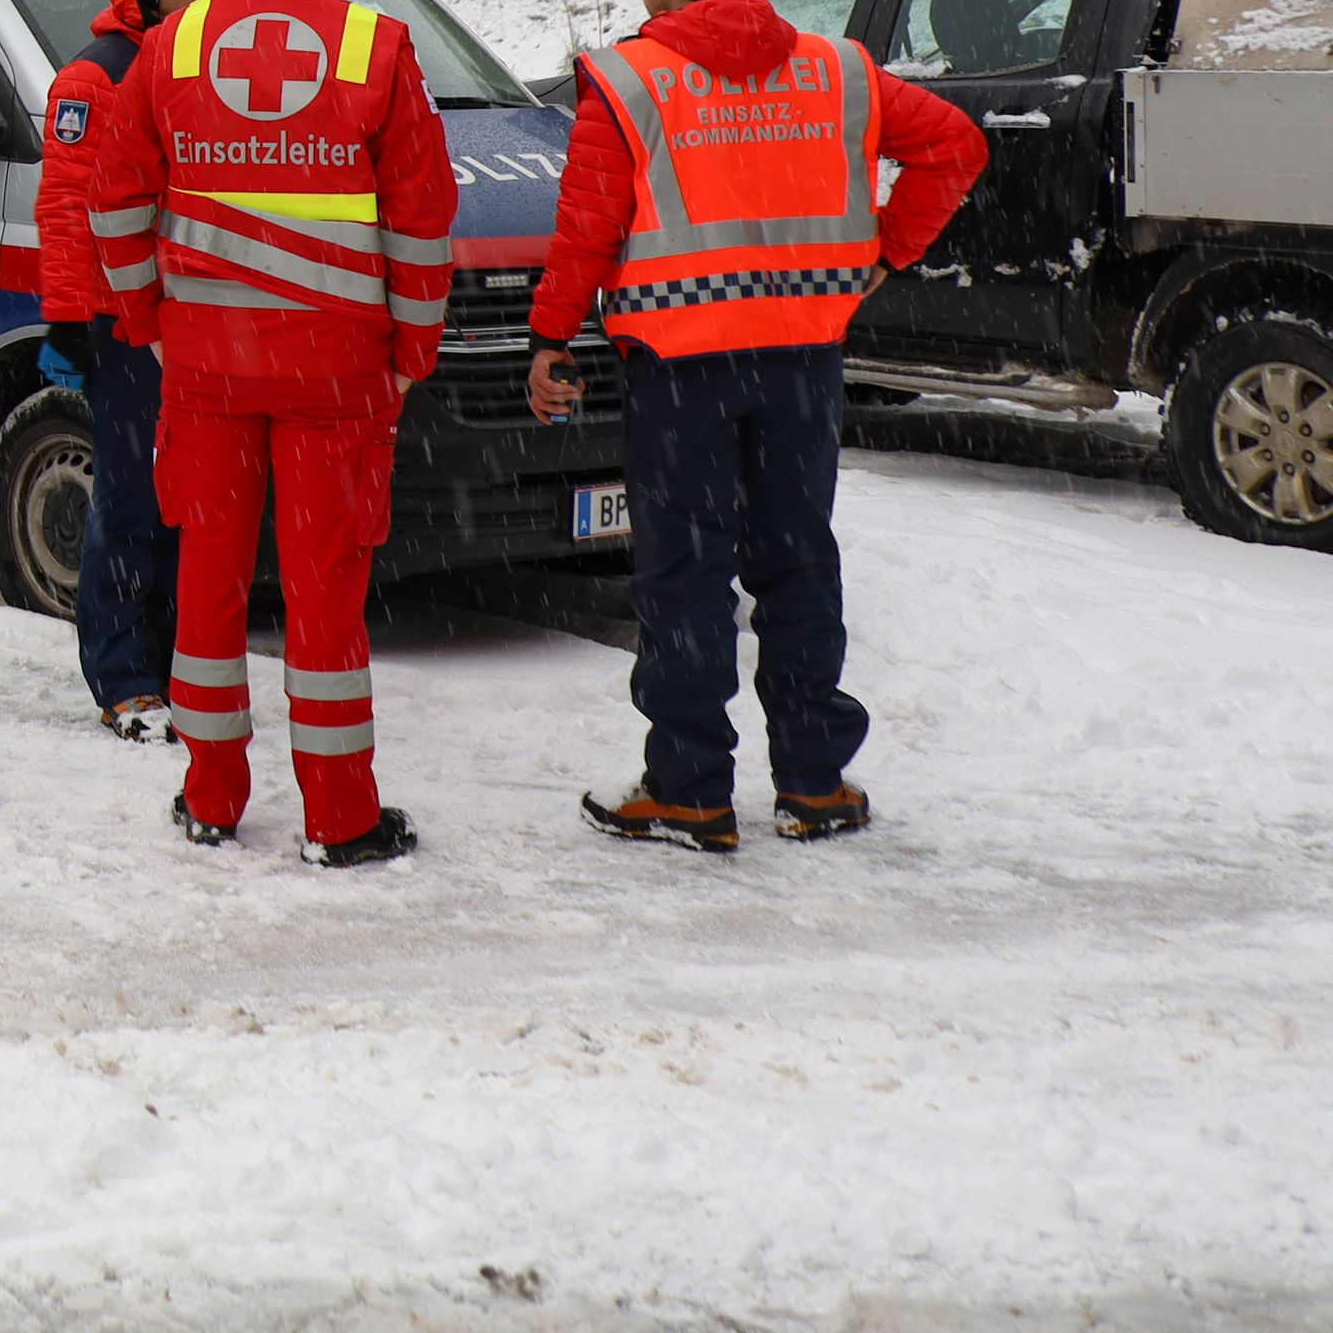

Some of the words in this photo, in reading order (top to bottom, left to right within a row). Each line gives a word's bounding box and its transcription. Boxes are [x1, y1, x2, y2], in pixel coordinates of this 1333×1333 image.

[649, 57, 830, 104] POLIZEI
[173, 130, 361, 166] Einsatzleiter
[671, 122, 836, 151] KOMMANDANT
[601, 493, 629, 527] BP
